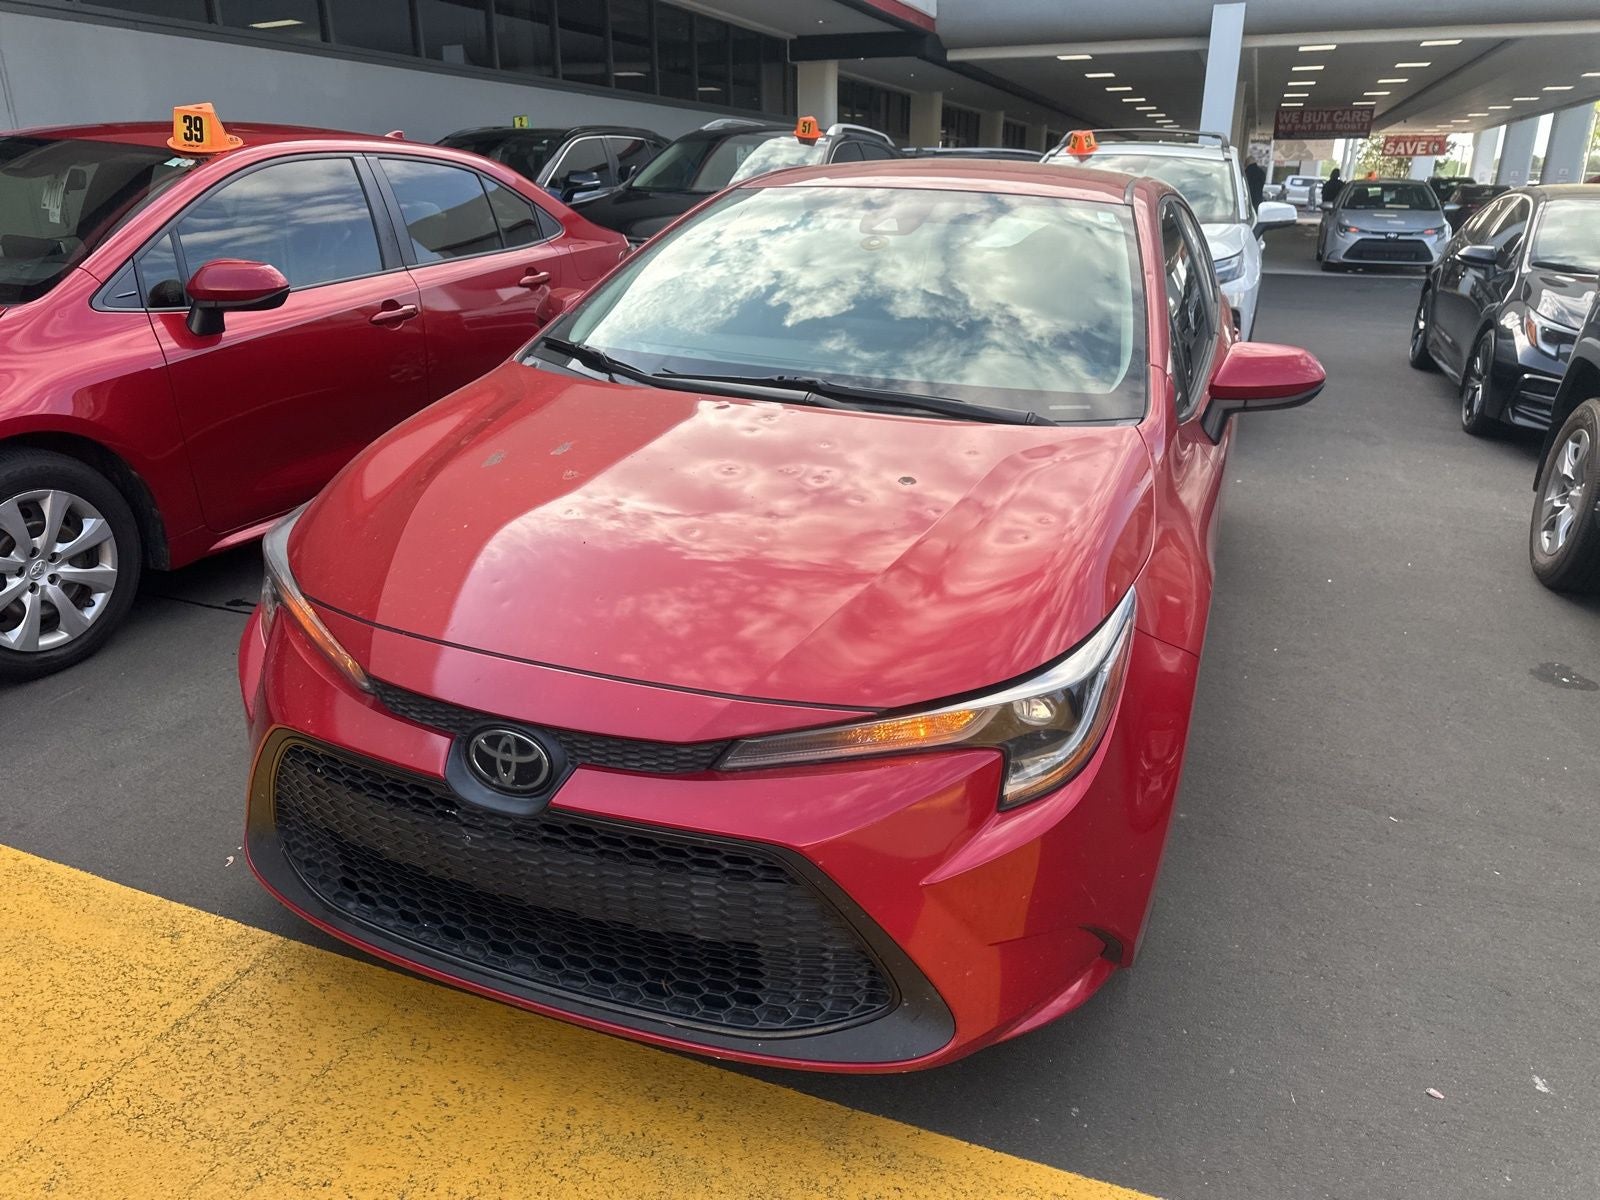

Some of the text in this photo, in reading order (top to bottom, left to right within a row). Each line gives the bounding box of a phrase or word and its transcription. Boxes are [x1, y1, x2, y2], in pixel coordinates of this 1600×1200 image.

[1279, 110, 1371, 124] WE BUY CARS
[183, 115, 204, 143] 39
[802, 121, 811, 134] 51
[1383, 141, 1427, 155] SAVE
